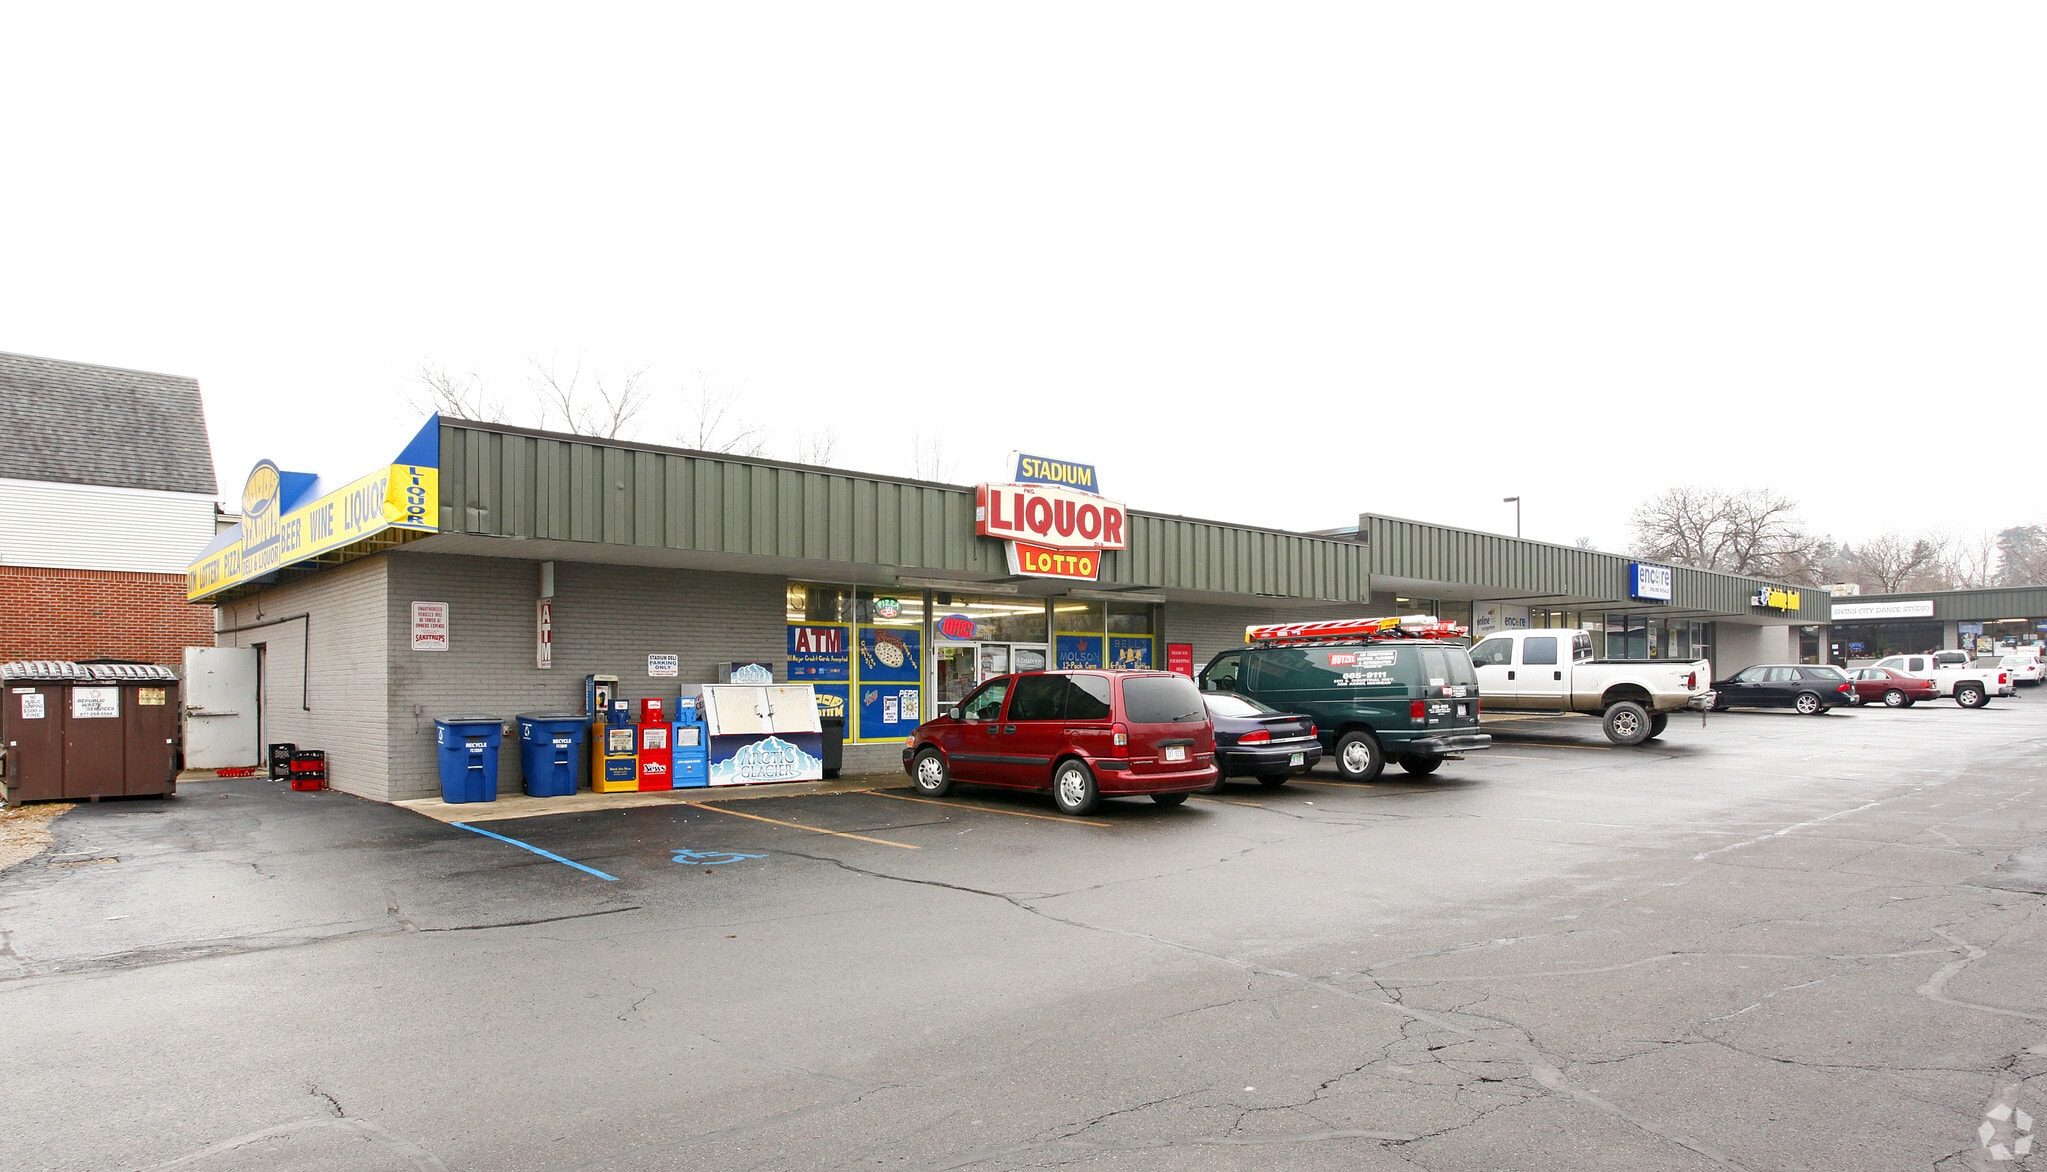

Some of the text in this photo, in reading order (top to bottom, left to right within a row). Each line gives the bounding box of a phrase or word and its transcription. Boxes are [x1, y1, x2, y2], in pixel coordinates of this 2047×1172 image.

[1022, 457, 1092, 487] STADIUM
[407, 466, 426, 525] LIQUOR
[281, 518, 301, 553] BEER
[310, 503, 334, 543] WINE
[990, 489, 1123, 544] LIQUOR
[200, 558, 220, 590] LOTTERY
[224, 548, 241, 579] PIZZA
[259, 545, 279, 569] LIQUOR
[1025, 551, 1092, 576] LOTTO
[1640, 567, 1670, 586] encore
[878, 600, 899, 610] PIZZA
[541, 604, 551, 661] ATM
[795, 628, 842, 653] ATM
[1060, 652, 1100, 661] MOLSON
[1331, 655, 1356, 664] HUTZEL
[741, 746, 795, 766] ARCTIC
[741, 764, 794, 778] GLACIER
